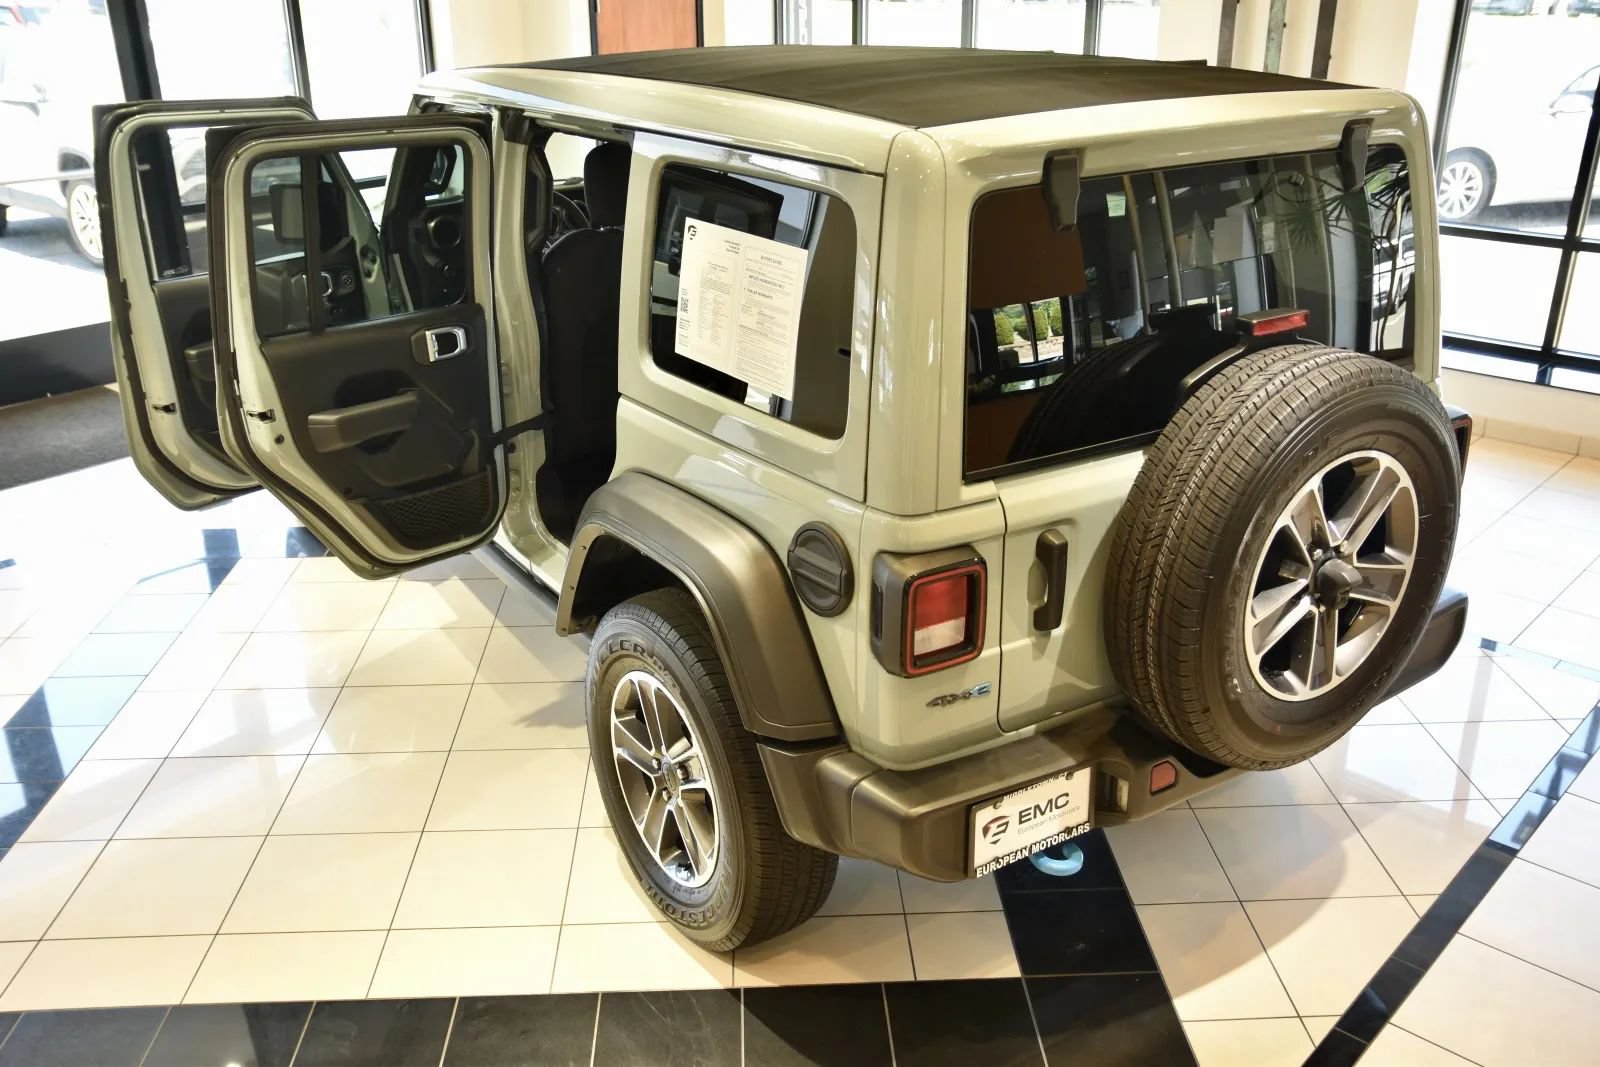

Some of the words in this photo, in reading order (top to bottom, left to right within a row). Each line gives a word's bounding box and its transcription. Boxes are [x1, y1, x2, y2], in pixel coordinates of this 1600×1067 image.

[1018, 792, 1070, 825] EMC
[1017, 819, 1048, 835] European
[976, 847, 1029, 878] EUROPEAN
[1031, 822, 1091, 855] MOTORCARS
